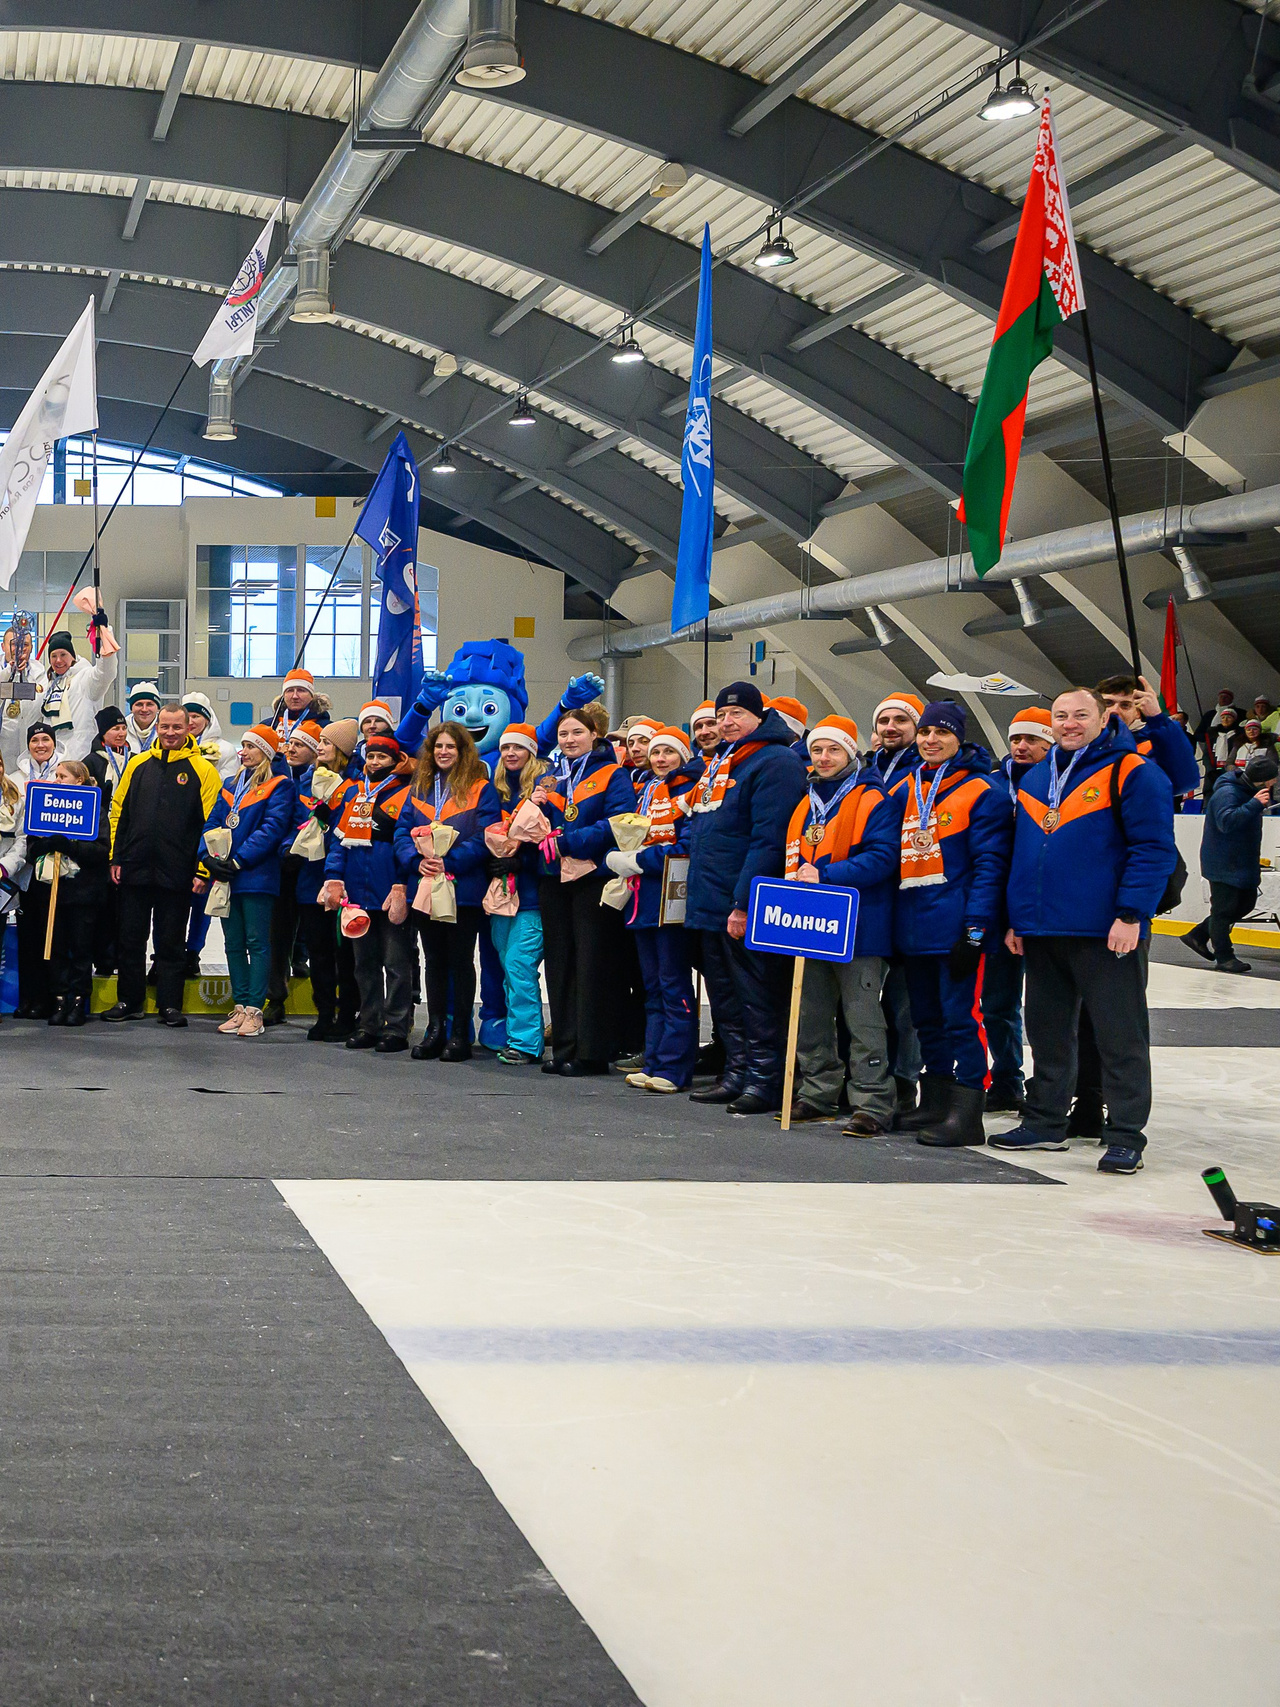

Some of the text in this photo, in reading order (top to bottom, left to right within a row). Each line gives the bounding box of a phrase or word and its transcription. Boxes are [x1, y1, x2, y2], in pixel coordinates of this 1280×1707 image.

[43, 793, 83, 810] Белые
[40, 811, 84, 828] тигры
[763, 904, 840, 936] Молния
